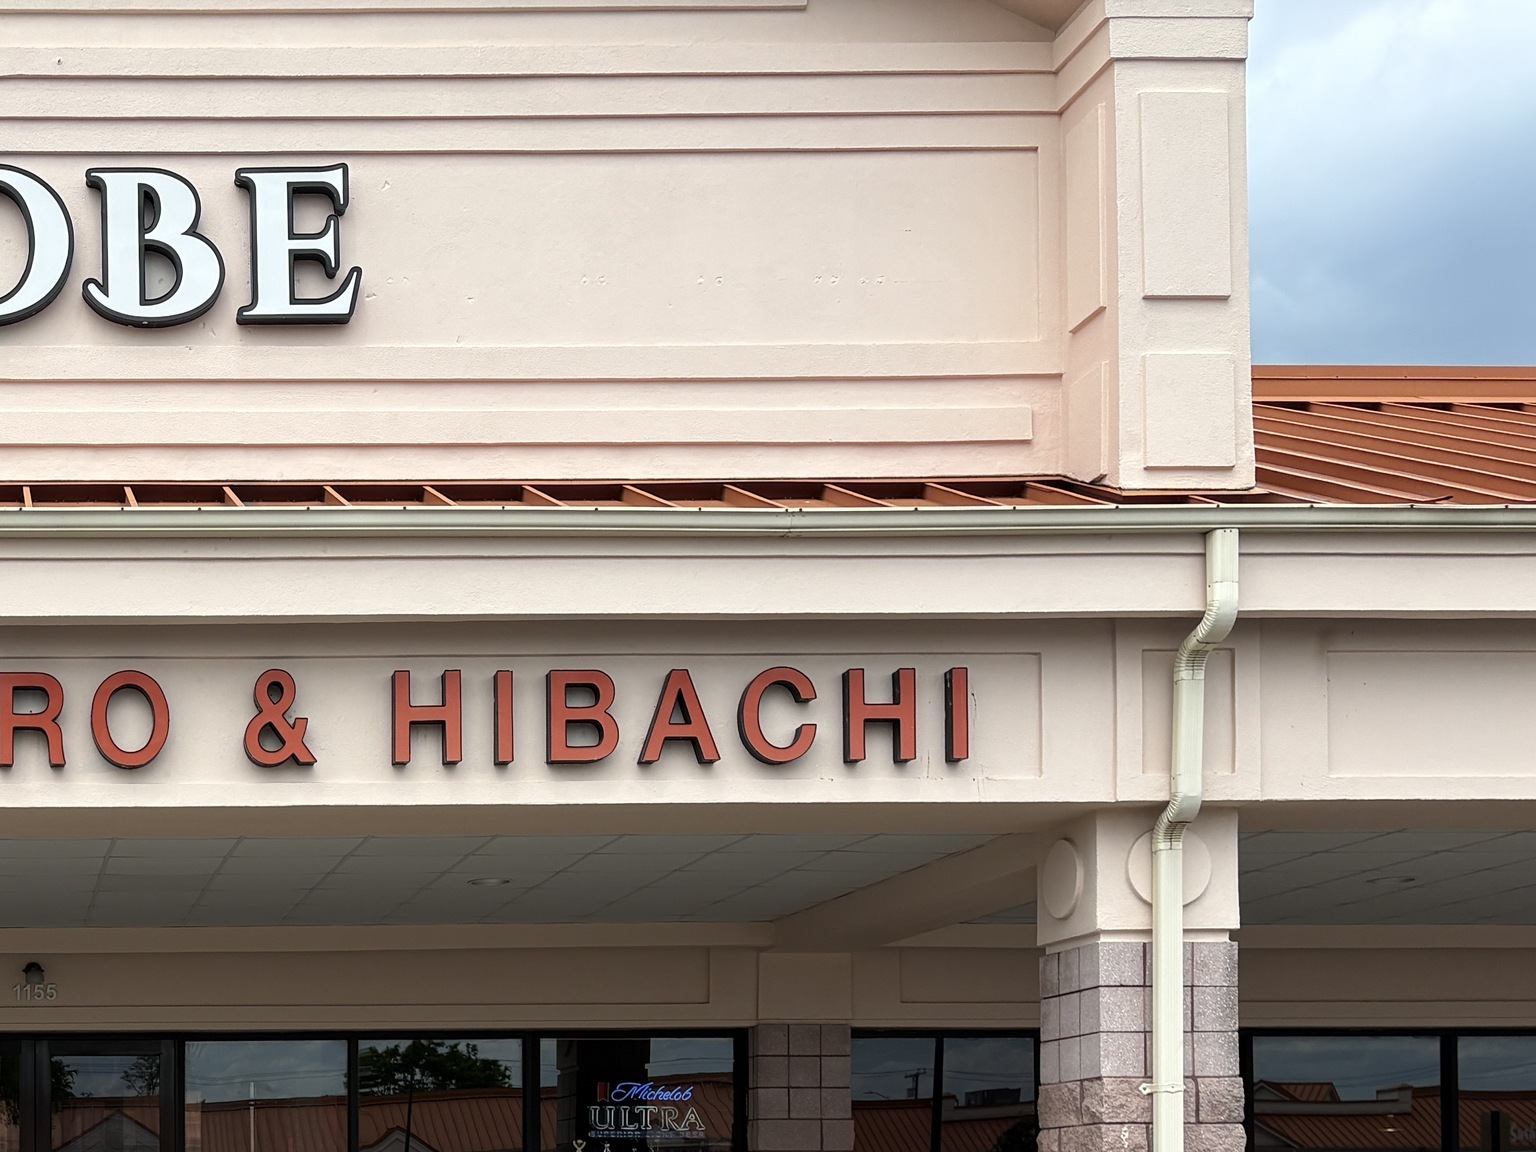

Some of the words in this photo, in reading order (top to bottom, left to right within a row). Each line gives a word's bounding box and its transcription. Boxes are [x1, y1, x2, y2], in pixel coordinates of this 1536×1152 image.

[242, 668, 317, 767] &
[391, 666, 970, 766] HIBACHI
[12, 983, 57, 1001] 1155
[610, 1081, 694, 1102] Michelob
[589, 1105, 706, 1131] ULTRA
